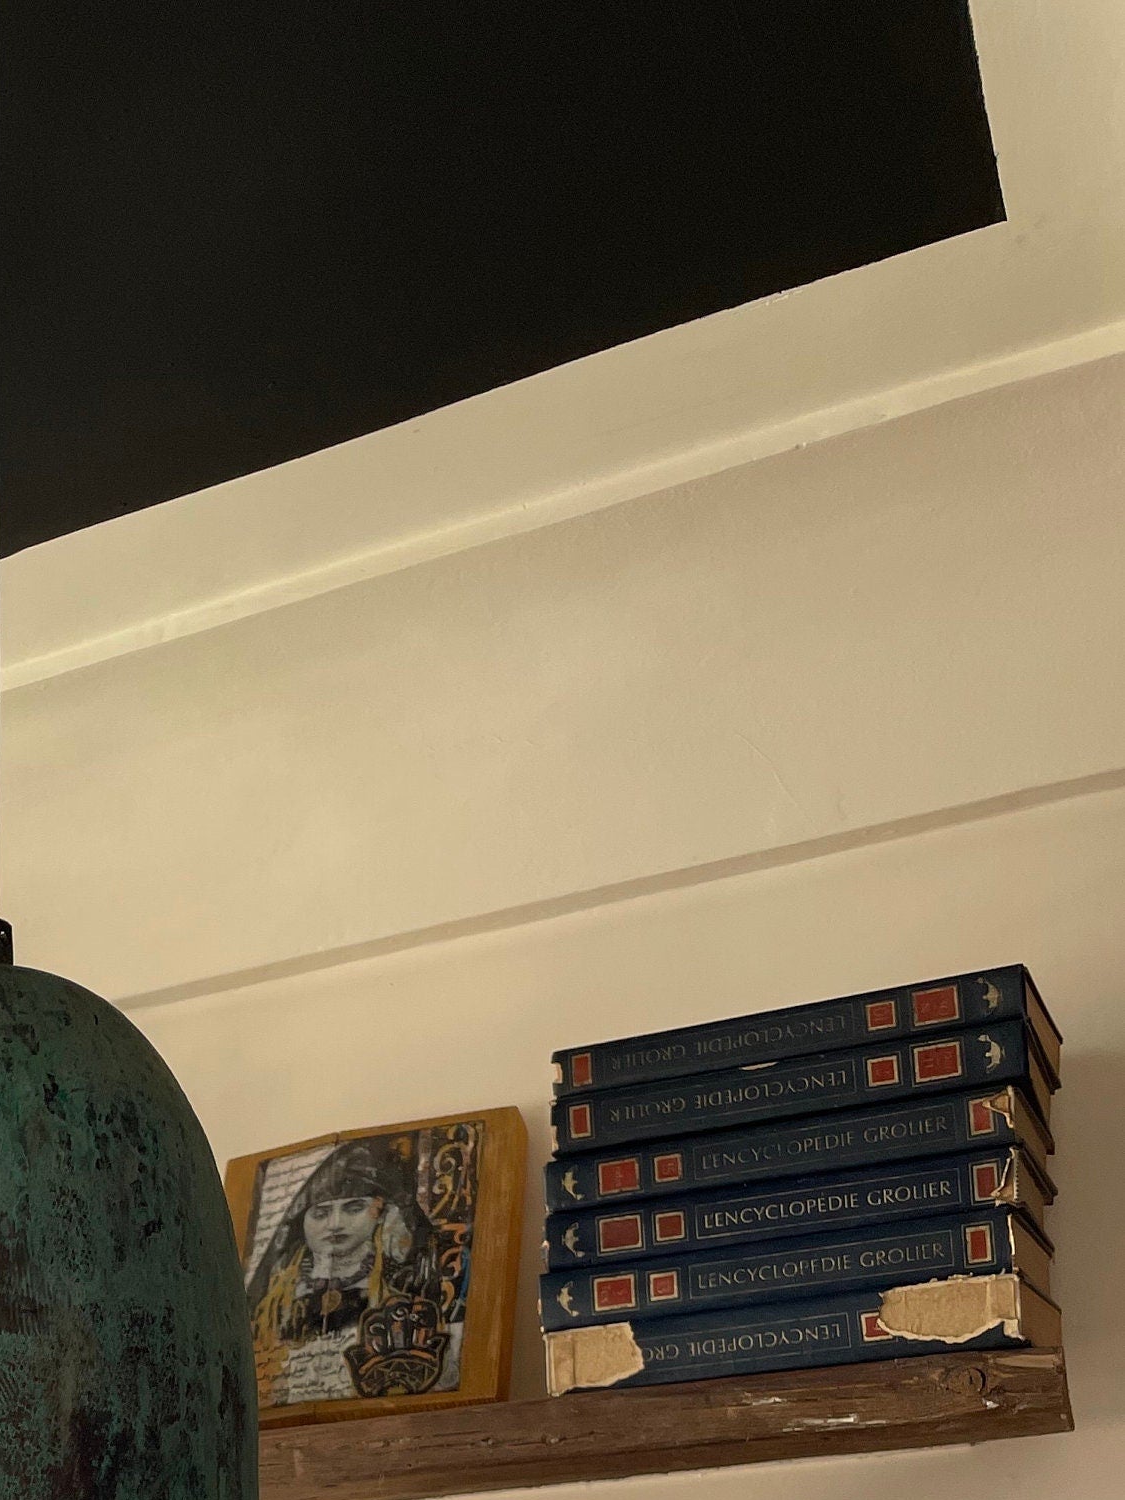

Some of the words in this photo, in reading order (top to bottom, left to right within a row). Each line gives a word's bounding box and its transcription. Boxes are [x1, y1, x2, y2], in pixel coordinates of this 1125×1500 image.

[611, 1045, 687, 1071] GROLIER
[609, 1099, 687, 1124] GROLIER
[862, 1115, 949, 1144] GROLIER
[866, 1179, 953, 1206] GROLIER
[859, 1243, 946, 1268] GROLIER
